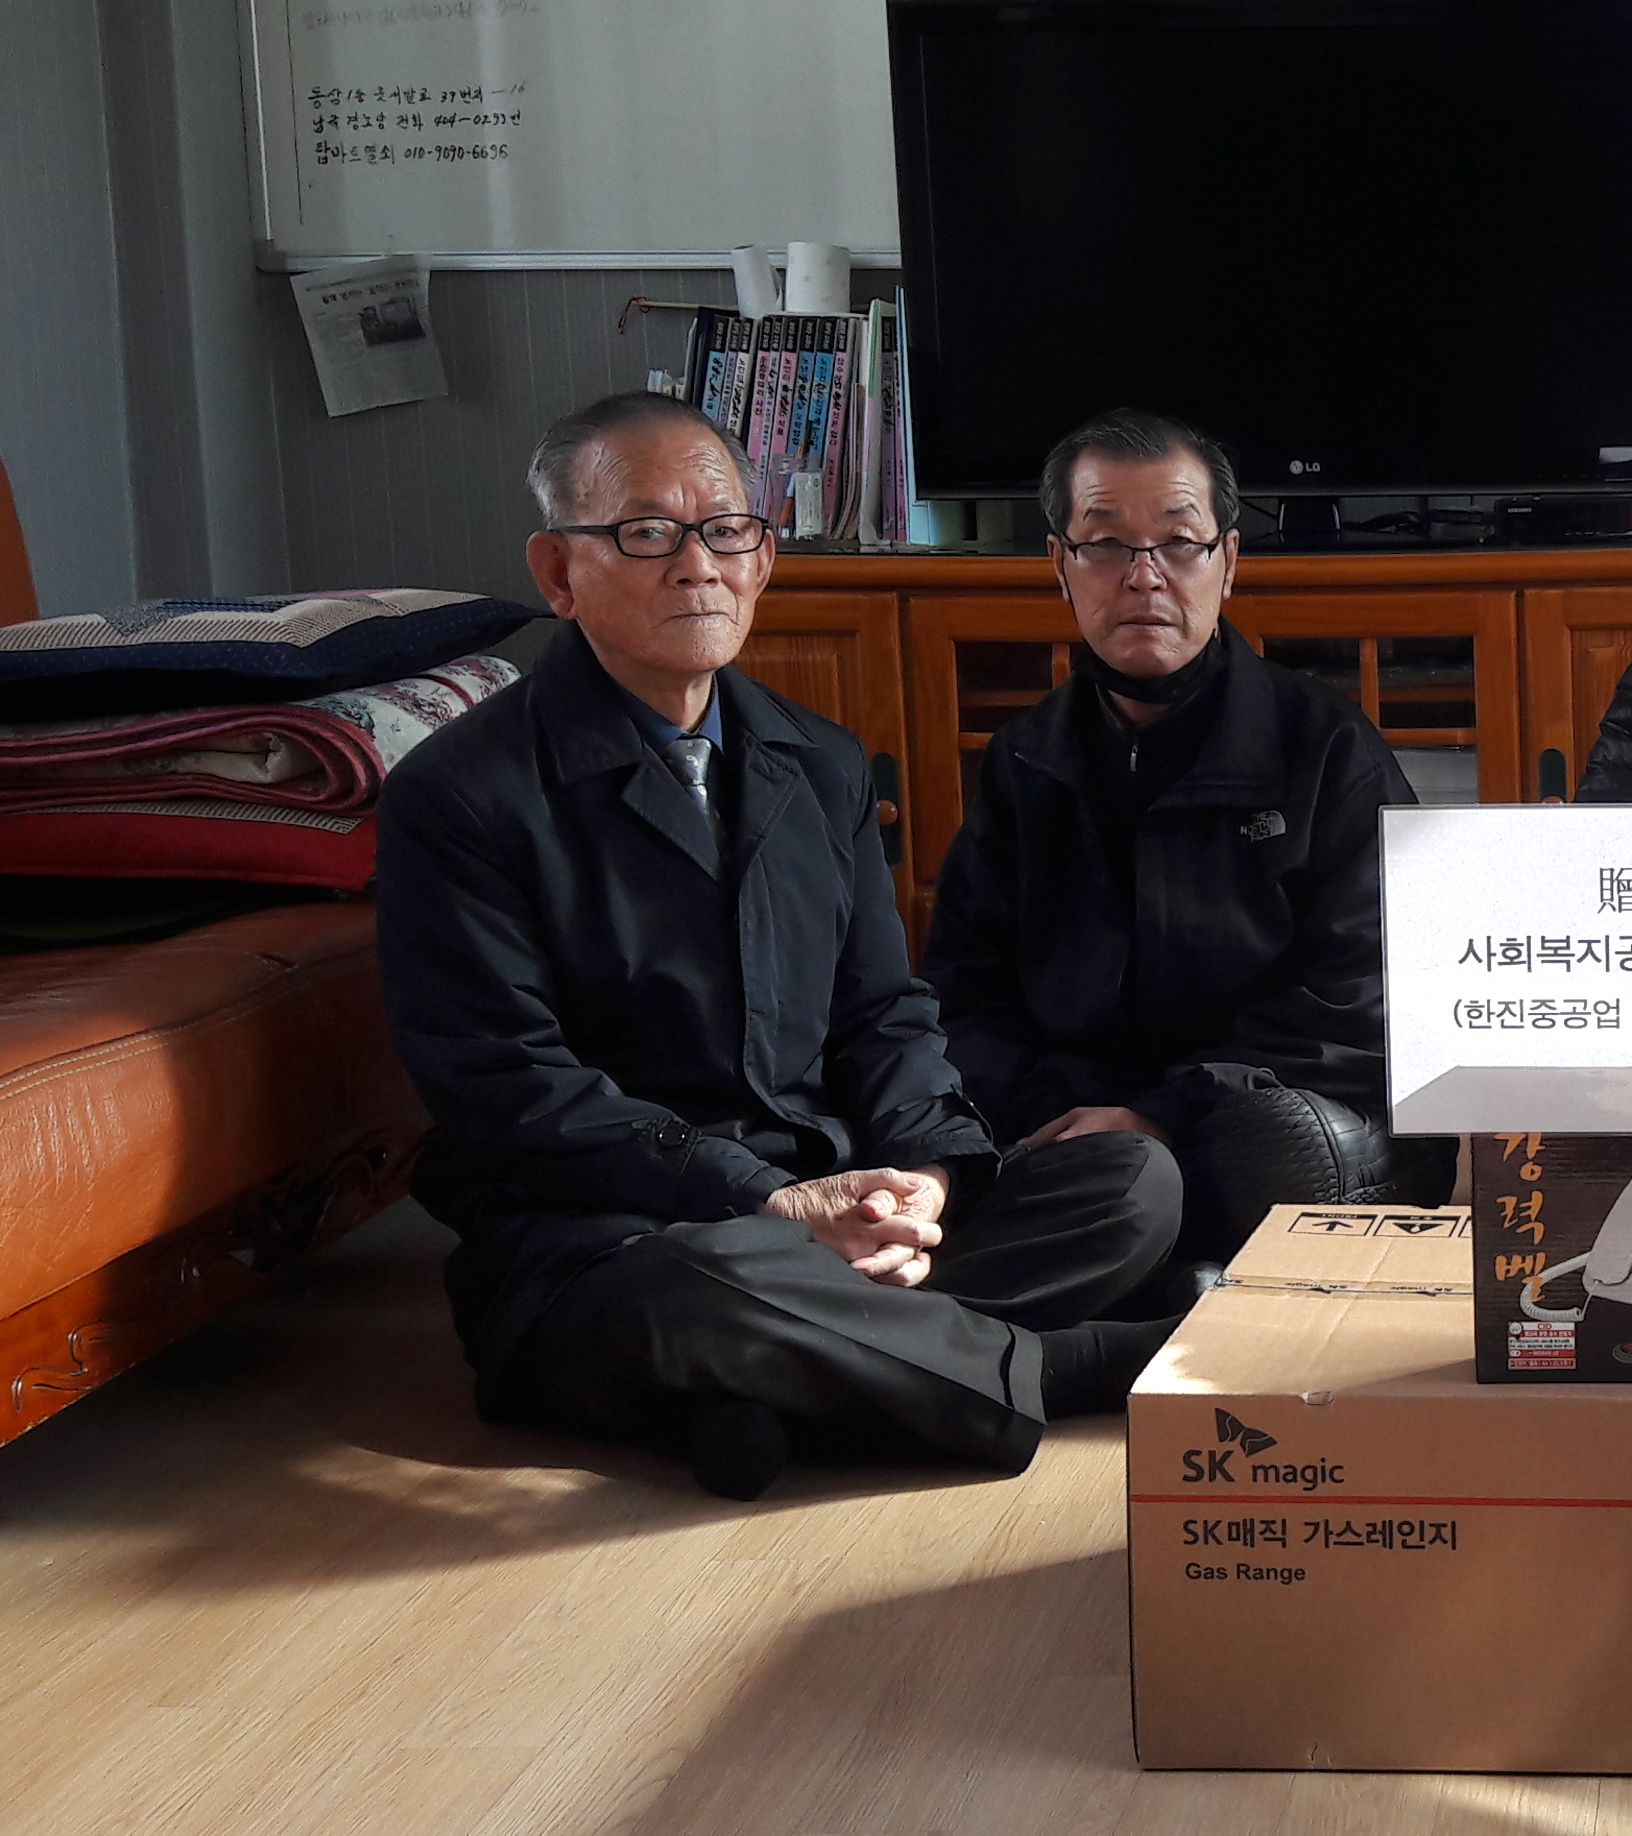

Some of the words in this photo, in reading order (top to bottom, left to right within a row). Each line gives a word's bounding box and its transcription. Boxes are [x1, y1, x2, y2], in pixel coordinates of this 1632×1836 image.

[1305, 462, 1321, 472] LG
[1452, 997, 1622, 1030] (한진중공업
[1182, 1449, 1236, 1483] SK
[1251, 1457, 1345, 1491] magic
[1183, 1518, 1288, 1548] SK매직
[1303, 1519, 1457, 1551] 가스레인지
[1185, 1563, 1228, 1580] Gas
[1236, 1563, 1306, 1585] Range
